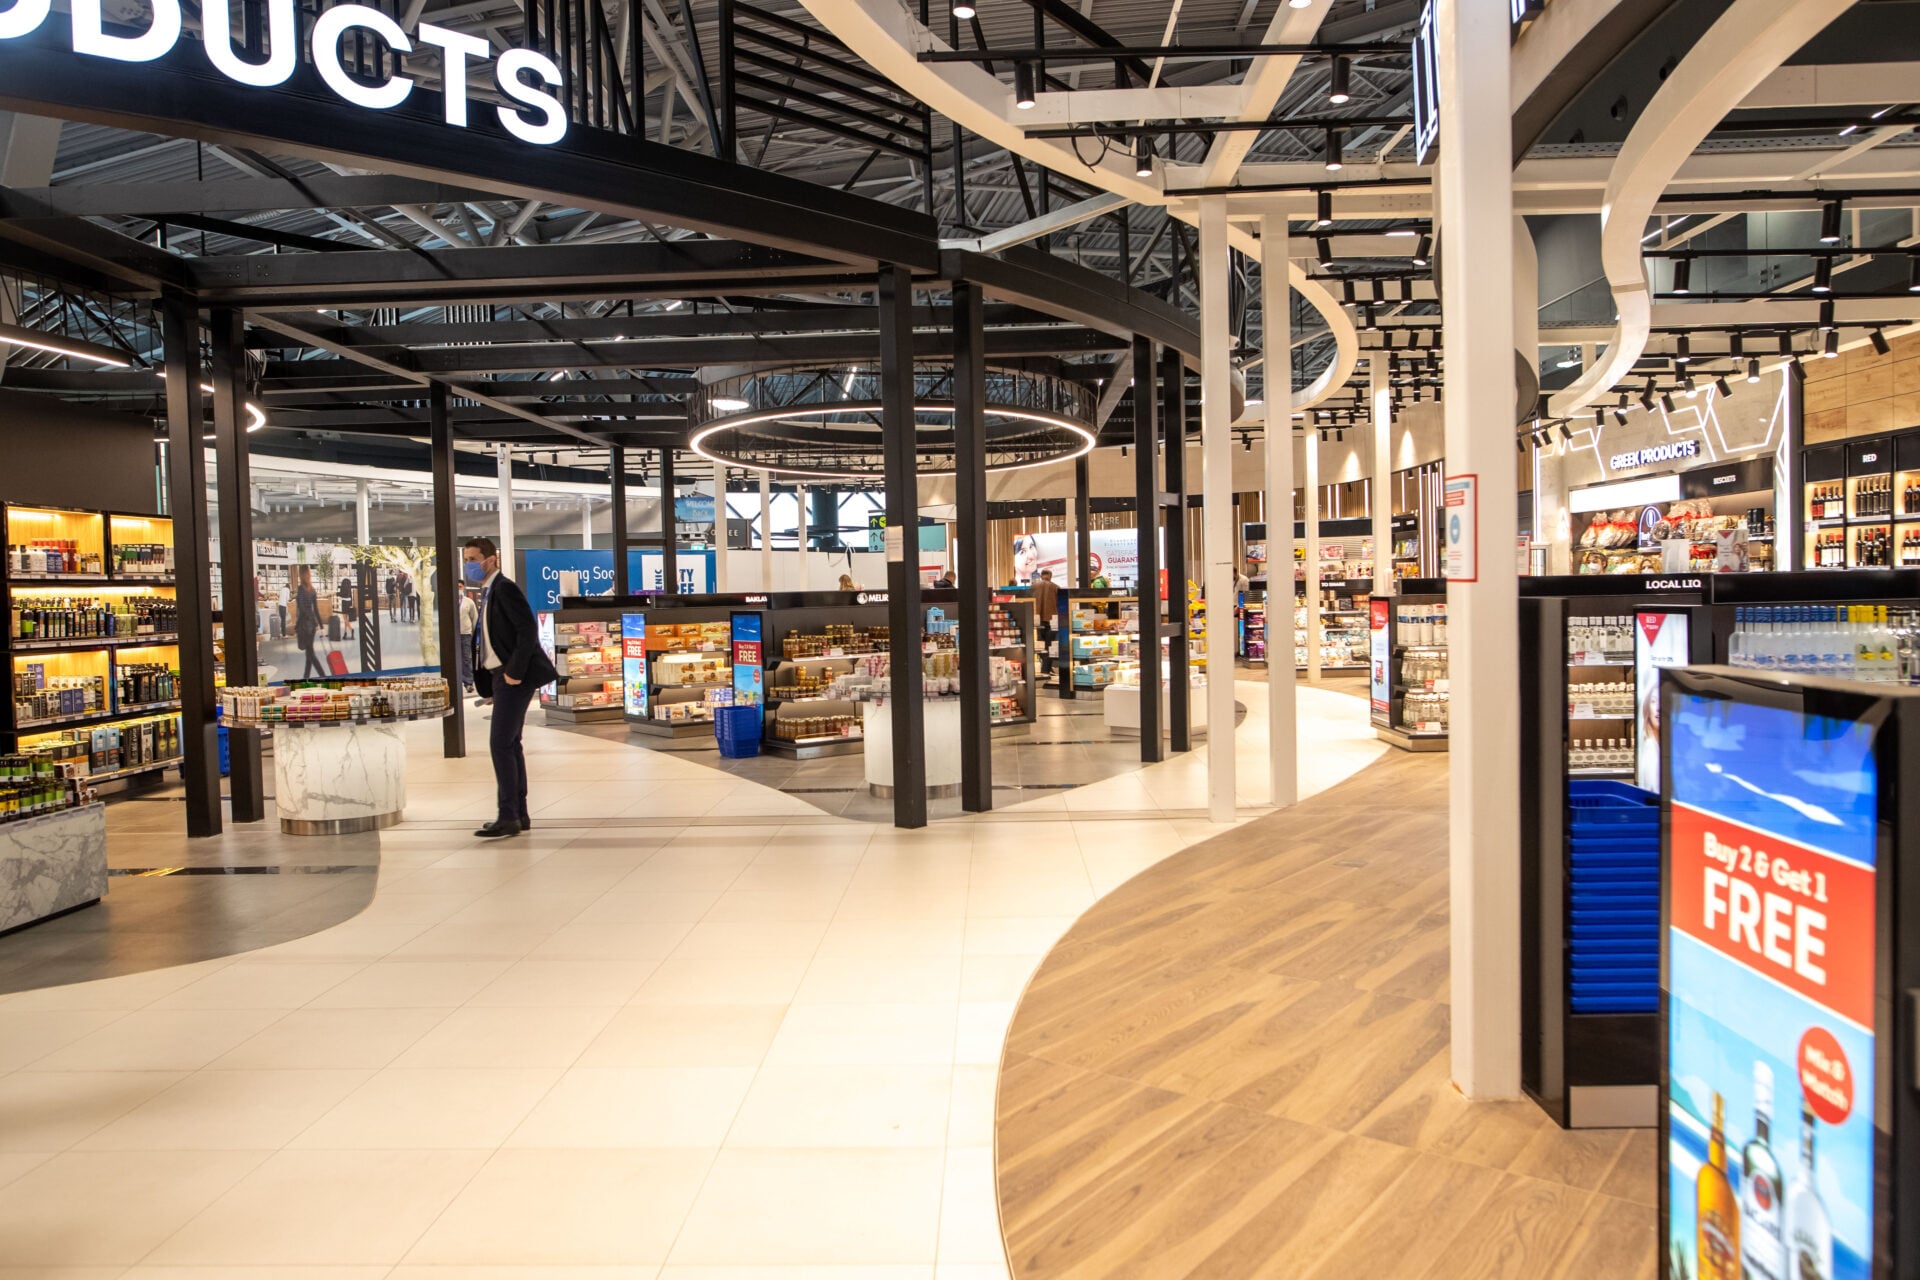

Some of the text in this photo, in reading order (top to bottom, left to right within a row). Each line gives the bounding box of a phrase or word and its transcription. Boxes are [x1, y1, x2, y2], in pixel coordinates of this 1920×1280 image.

[1610, 440, 1696, 470] GREEK PRODUCTS
[1862, 453, 1878, 463] RED
[676, 583, 695, 594] EE
[1645, 579, 1702, 589] LOCAL LIQ
[627, 645, 642, 656] FREE
[738, 650, 757, 663] FREE
[1703, 831, 1828, 903] Buy 2 & Get 1
[1703, 866, 1828, 986] FREE
